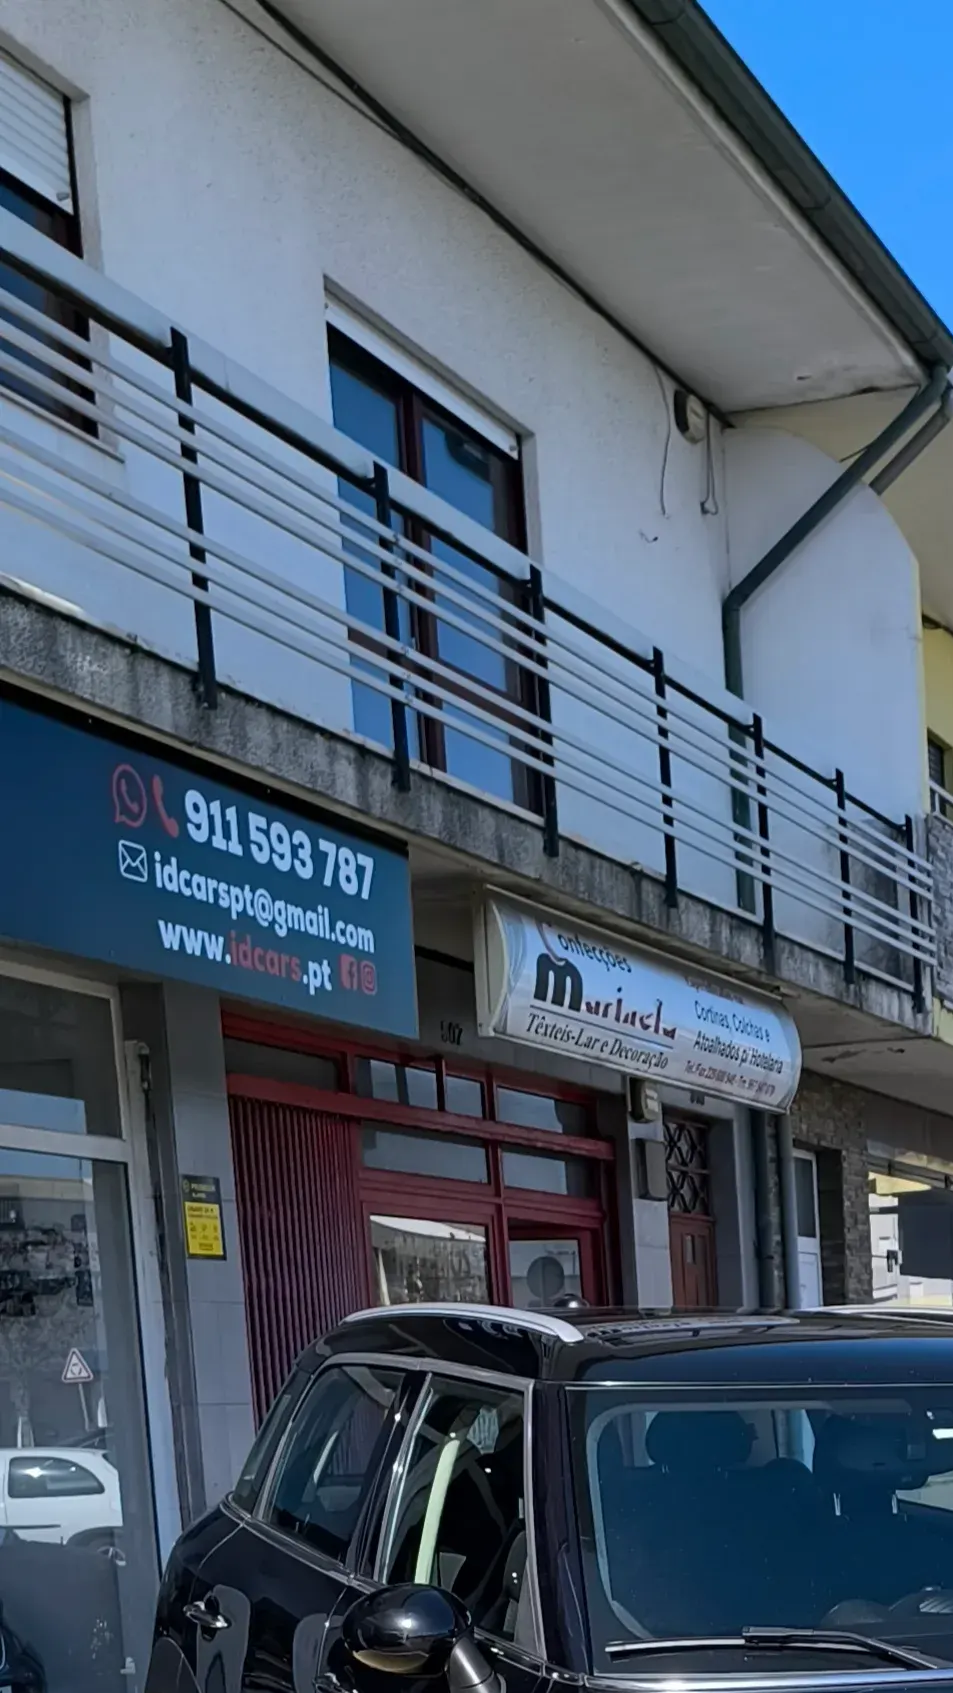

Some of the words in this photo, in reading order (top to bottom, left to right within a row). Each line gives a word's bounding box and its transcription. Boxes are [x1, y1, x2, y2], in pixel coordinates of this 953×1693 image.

[185, 789, 243, 857] 911
[248, 811, 314, 880] 593
[318, 838, 374, 900] 787
[154, 850, 375, 954] idcarspt@gmail.com
[158, 919, 333, 995] www.idcars.pt
[526, 1013, 599, 1051] Têxteis-Lar
[599, 1038, 609, 1053] e
[608, 1037, 669, 1070] Decoração
